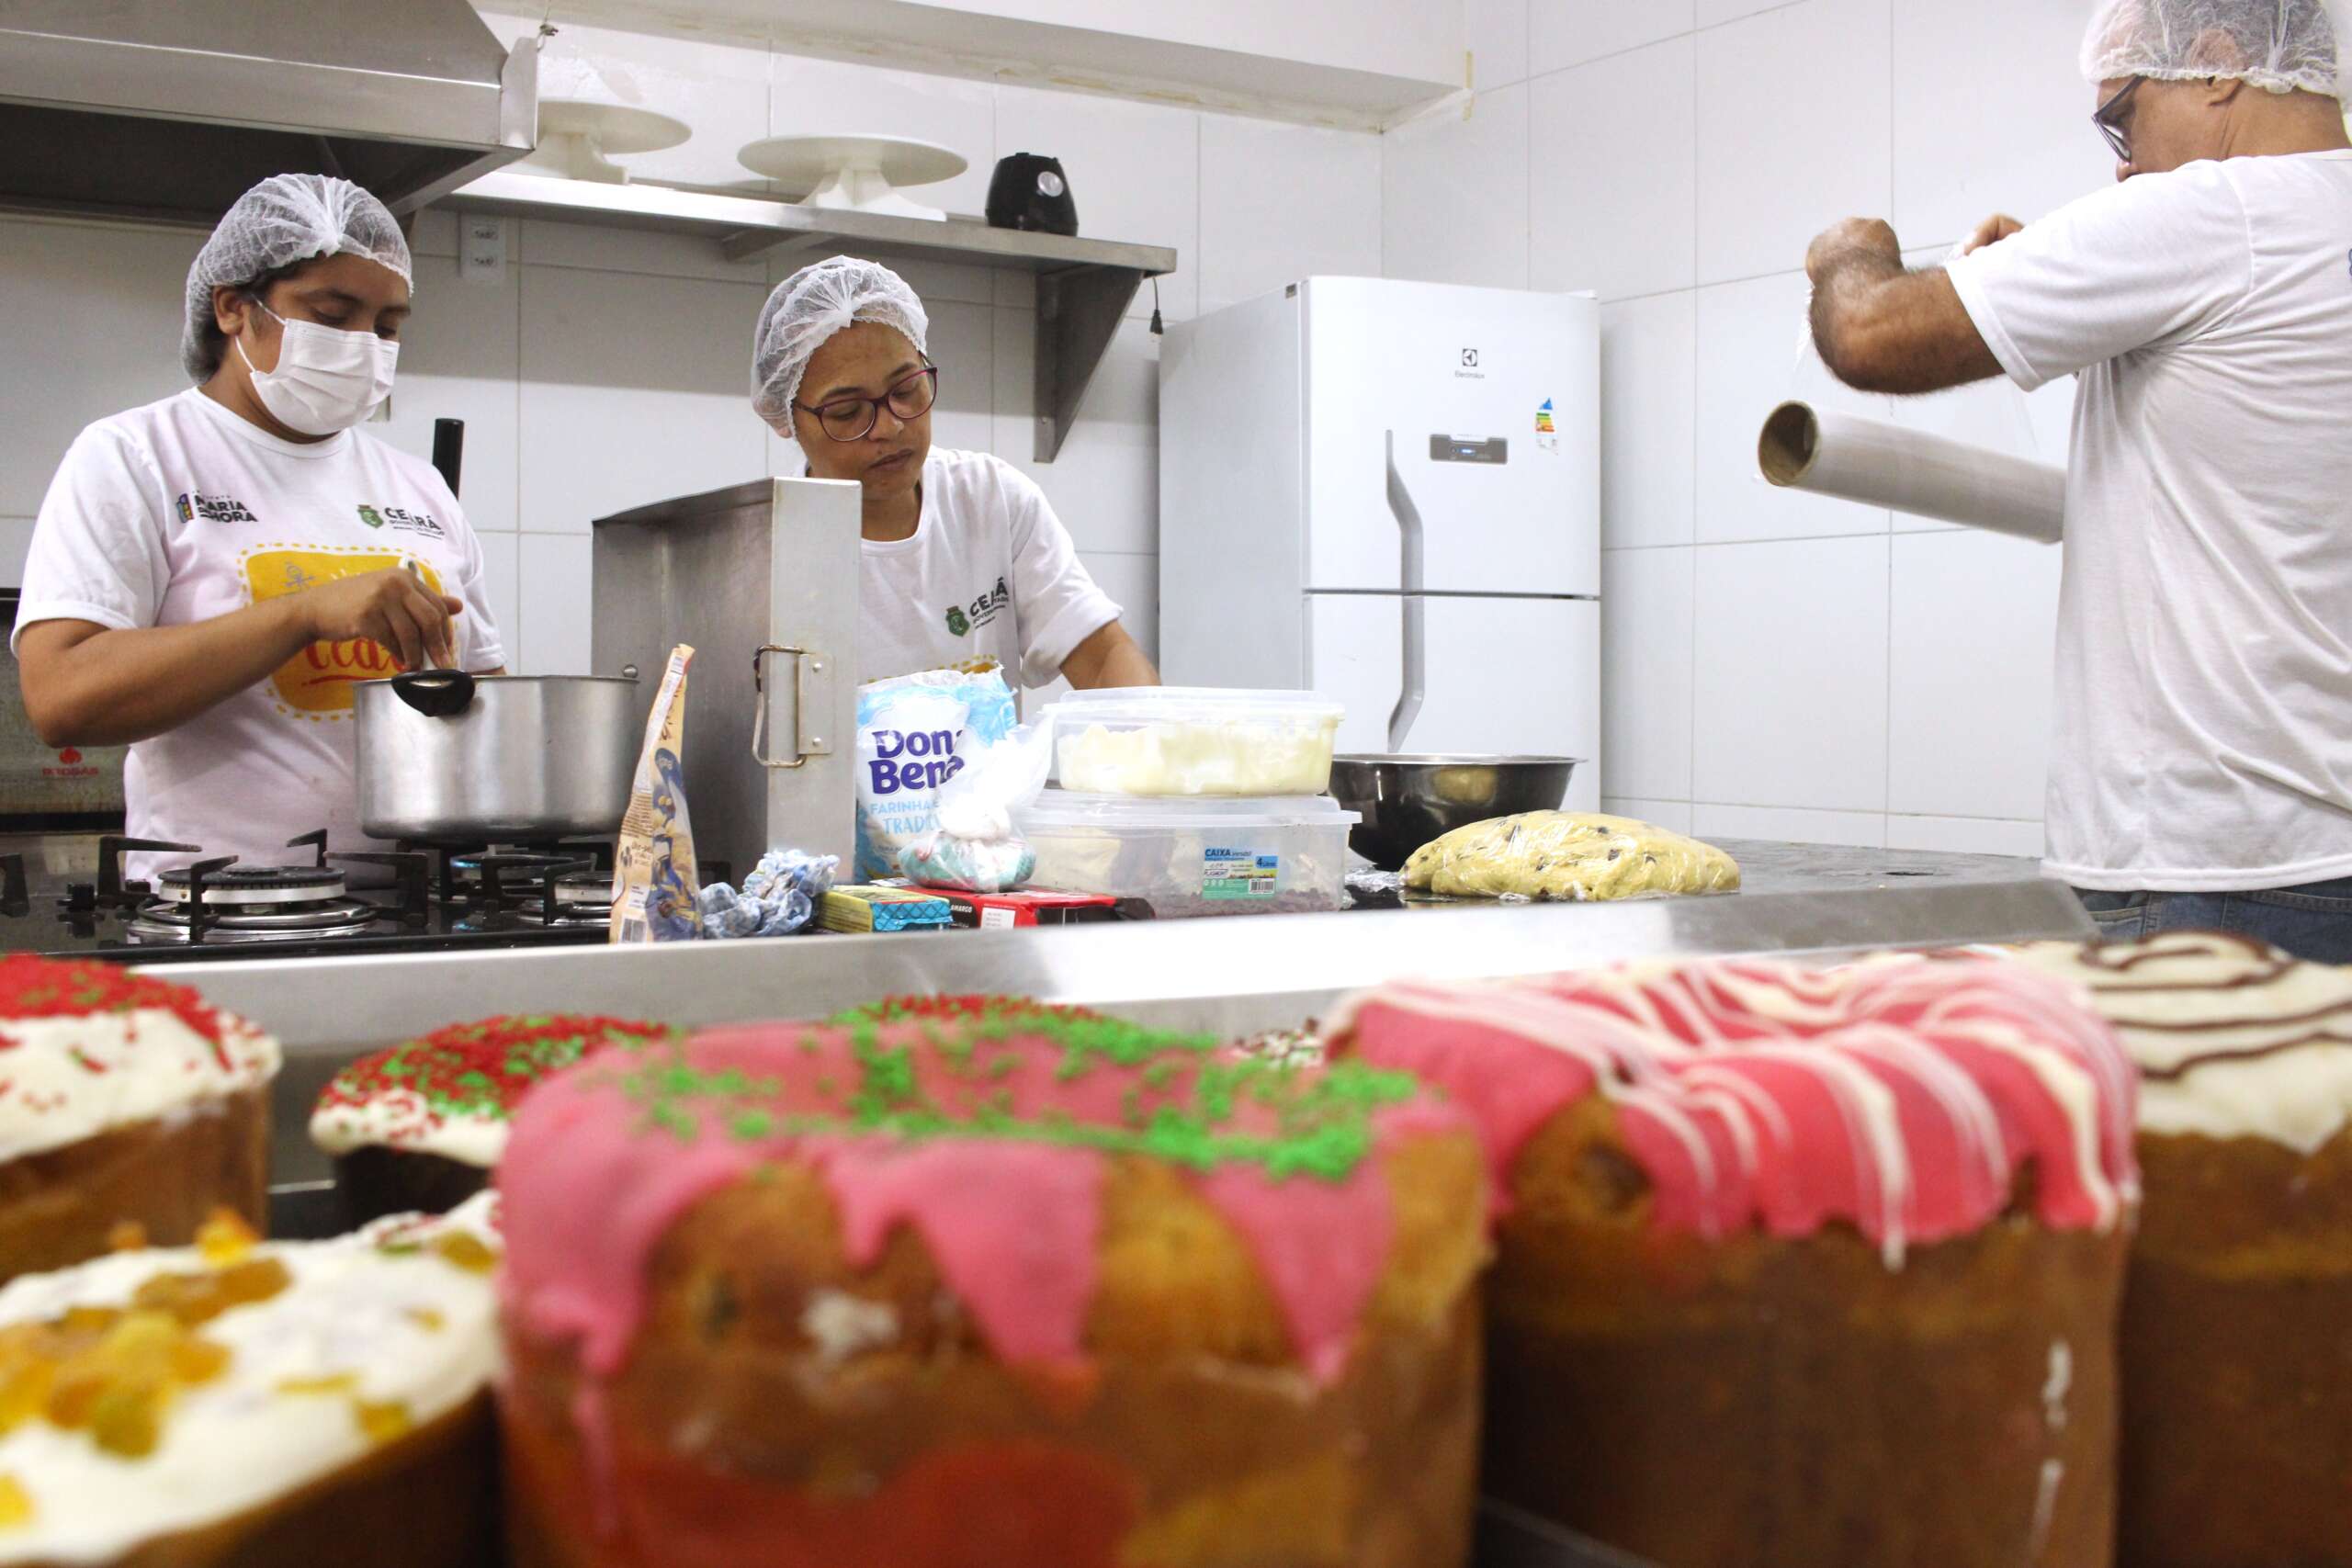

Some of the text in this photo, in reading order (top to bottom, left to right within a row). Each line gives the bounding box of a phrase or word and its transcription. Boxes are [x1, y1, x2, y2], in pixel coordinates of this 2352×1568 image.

[970, 576, 1009, 616] CEÁ
[871, 729, 963, 759] Don
[869, 799, 932, 815] FARINHA
[1204, 848, 1230, 856] CAIXA
